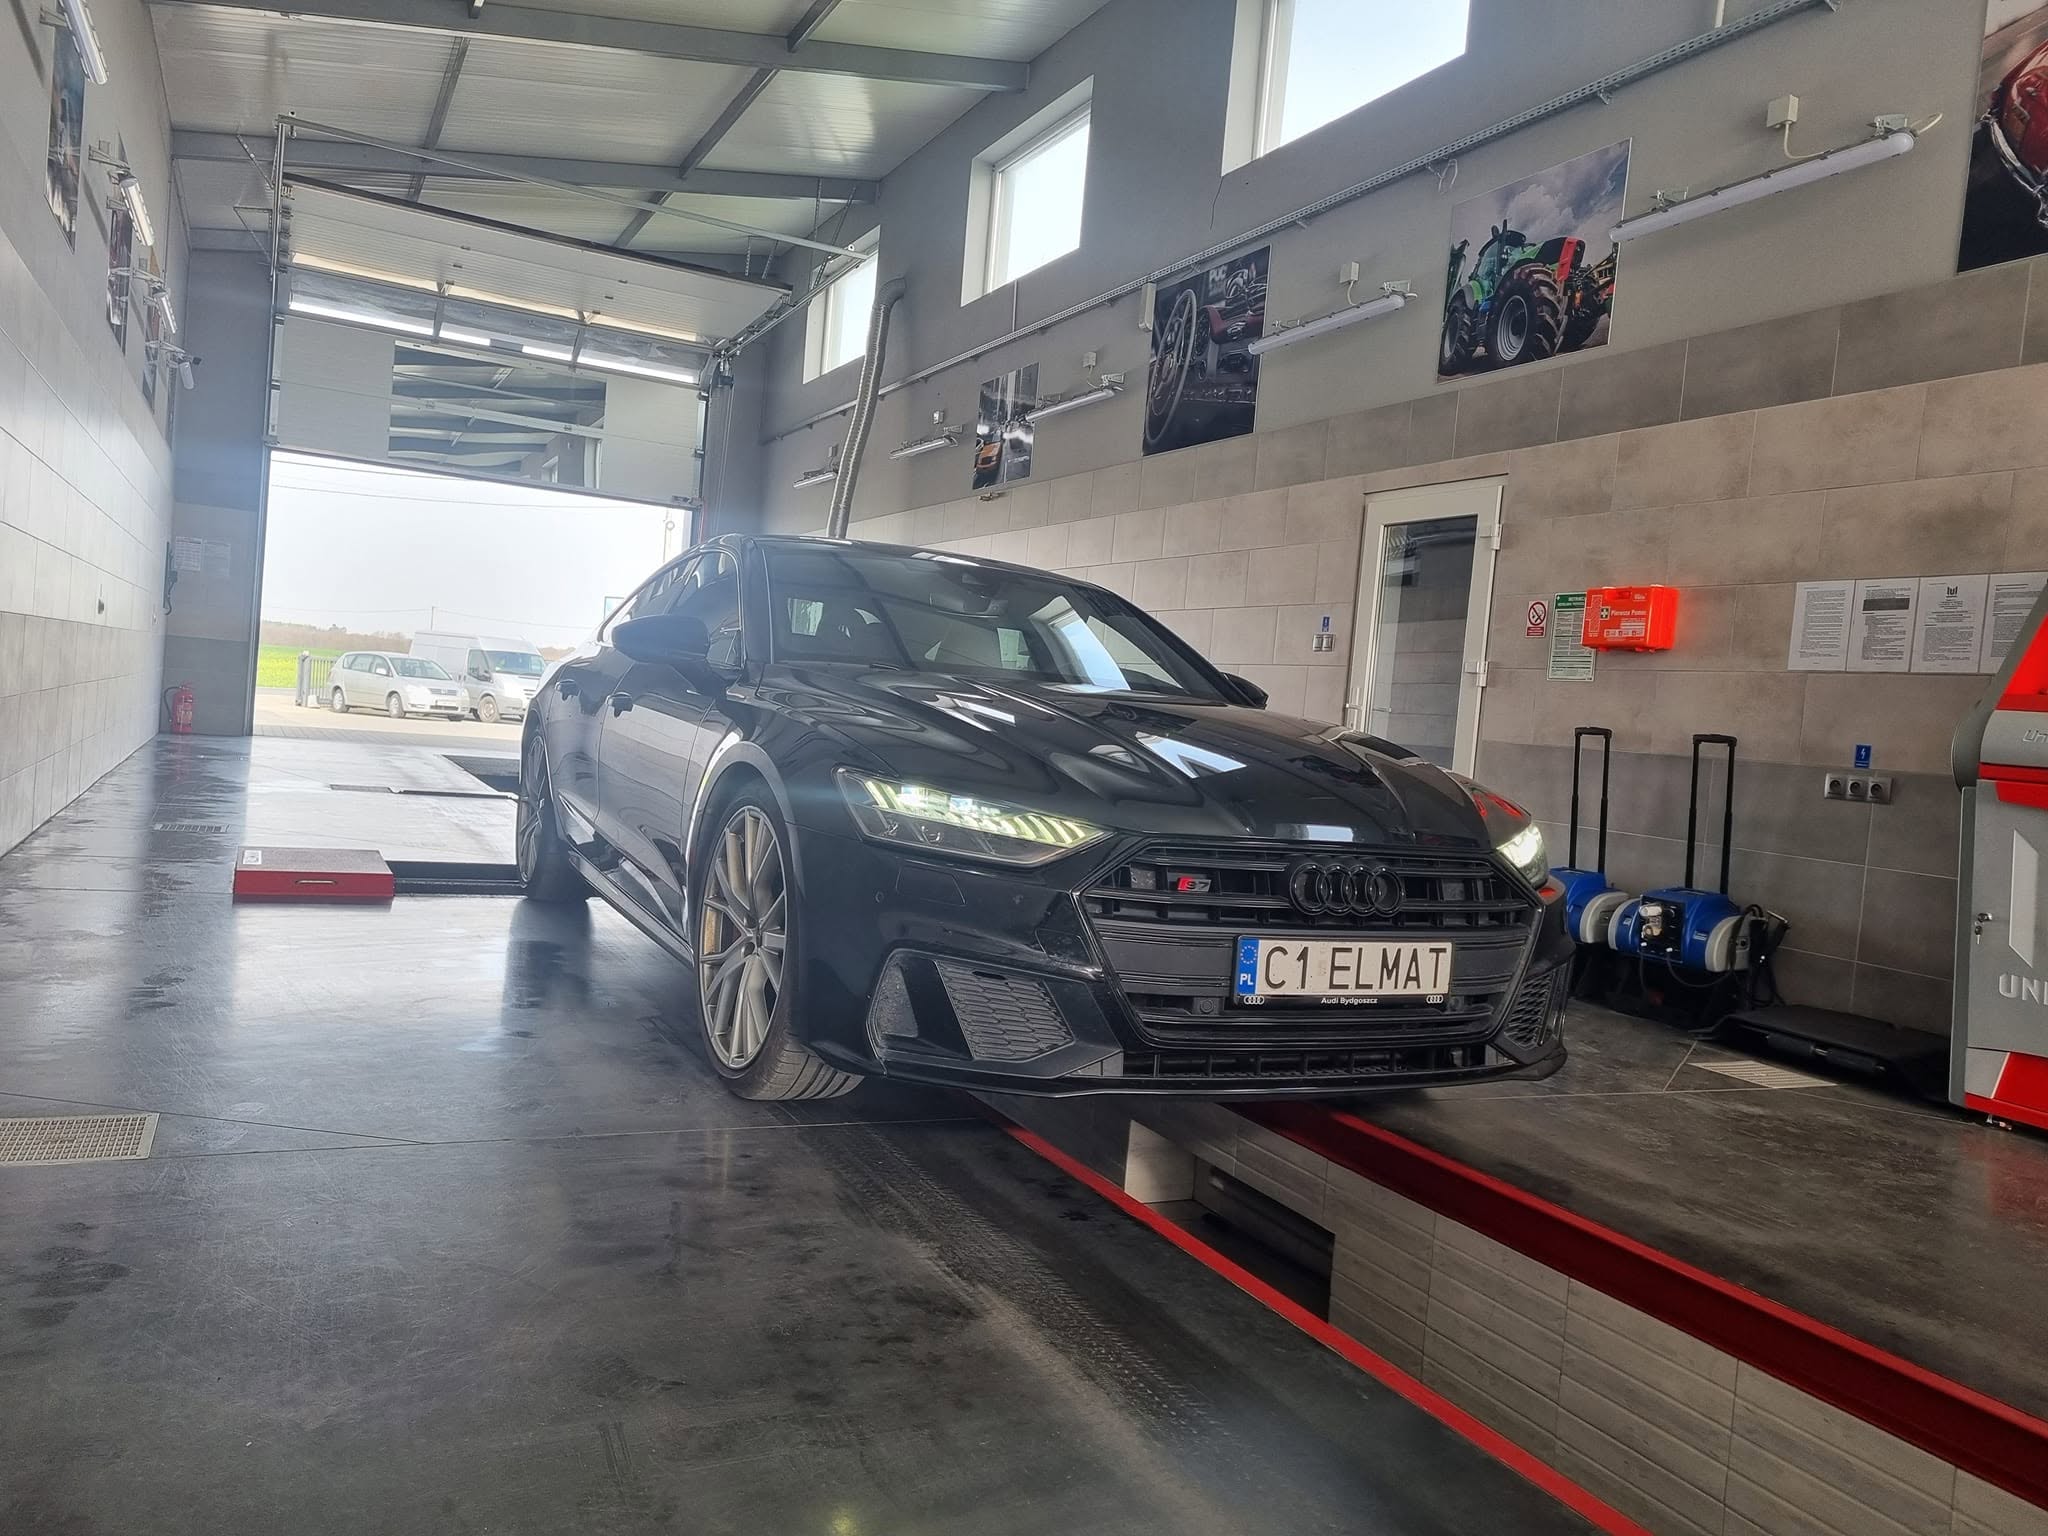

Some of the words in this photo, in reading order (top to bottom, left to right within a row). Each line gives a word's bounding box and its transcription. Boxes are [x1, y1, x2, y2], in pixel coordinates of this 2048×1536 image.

[1264, 945, 1310, 990] C1
[1328, 946, 1448, 990] ELMAT
[1239, 973, 1254, 986] PL
[1321, 996, 1339, 1005] Audi
[1339, 996, 1378, 1006] Bydgoszcz
